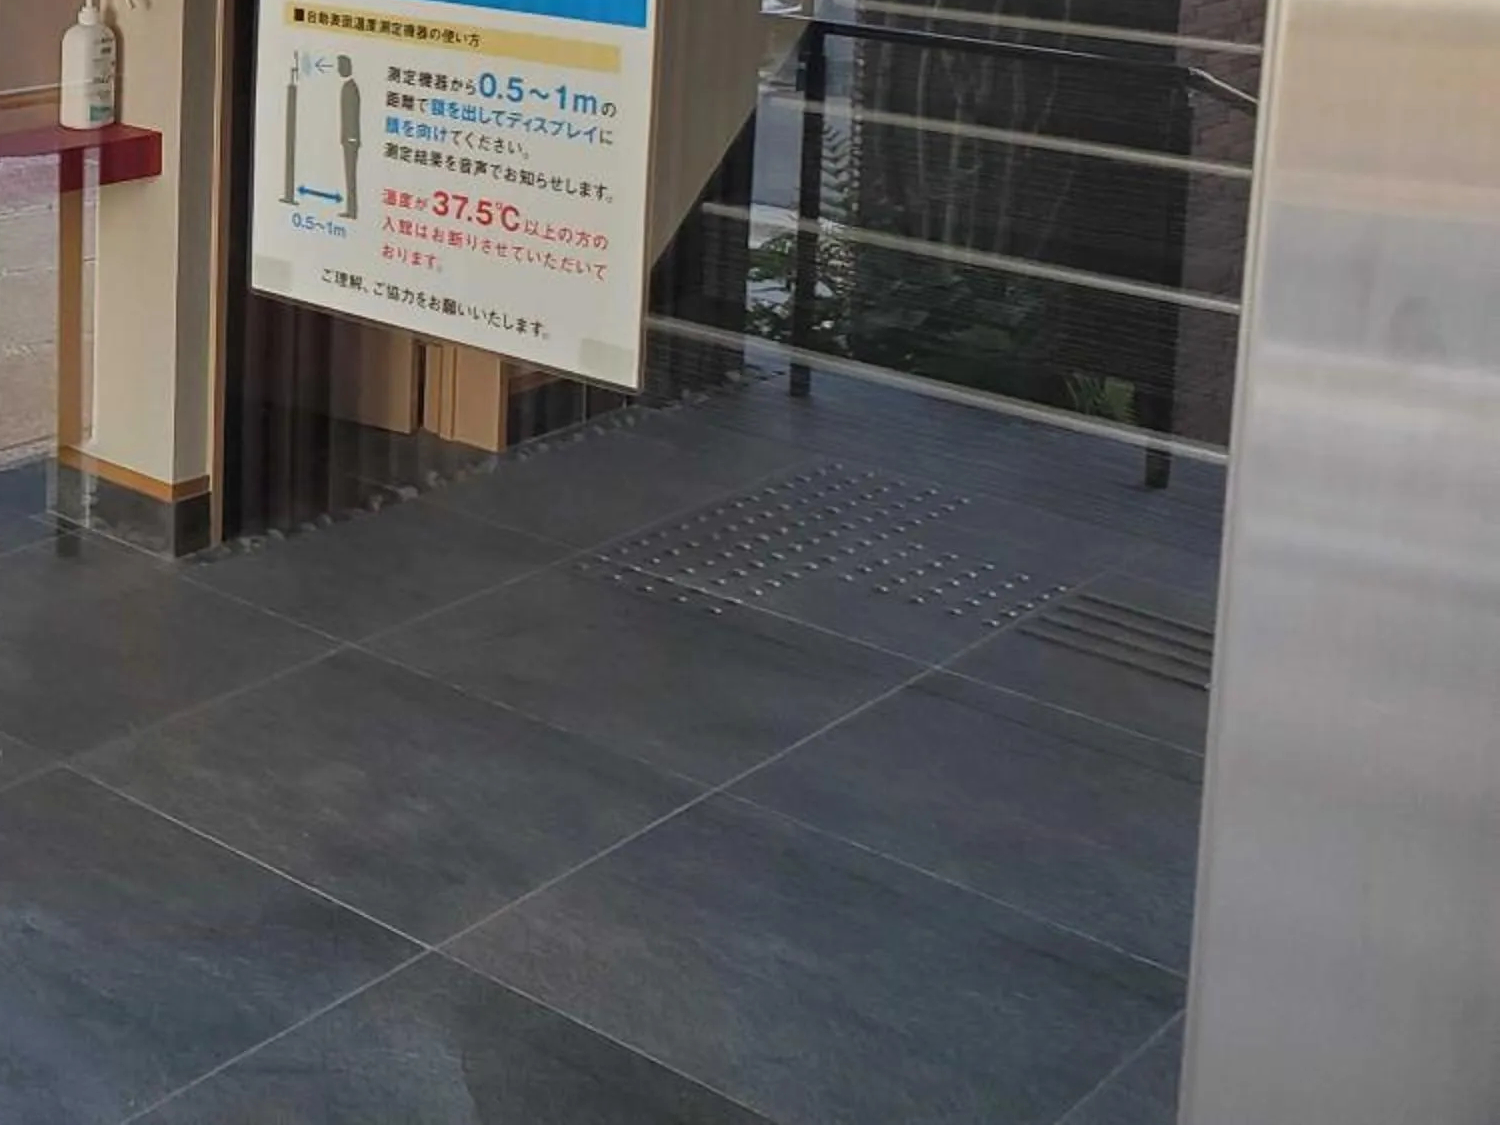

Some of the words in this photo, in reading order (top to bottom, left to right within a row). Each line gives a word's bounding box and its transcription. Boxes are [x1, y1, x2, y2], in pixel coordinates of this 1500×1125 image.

[384, 142, 614, 204] 測定結果を音声でお知らせします。
[382, 244, 443, 273] おります。
[321, 268, 550, 339] ご理解、ご協力をお願いいたします。
